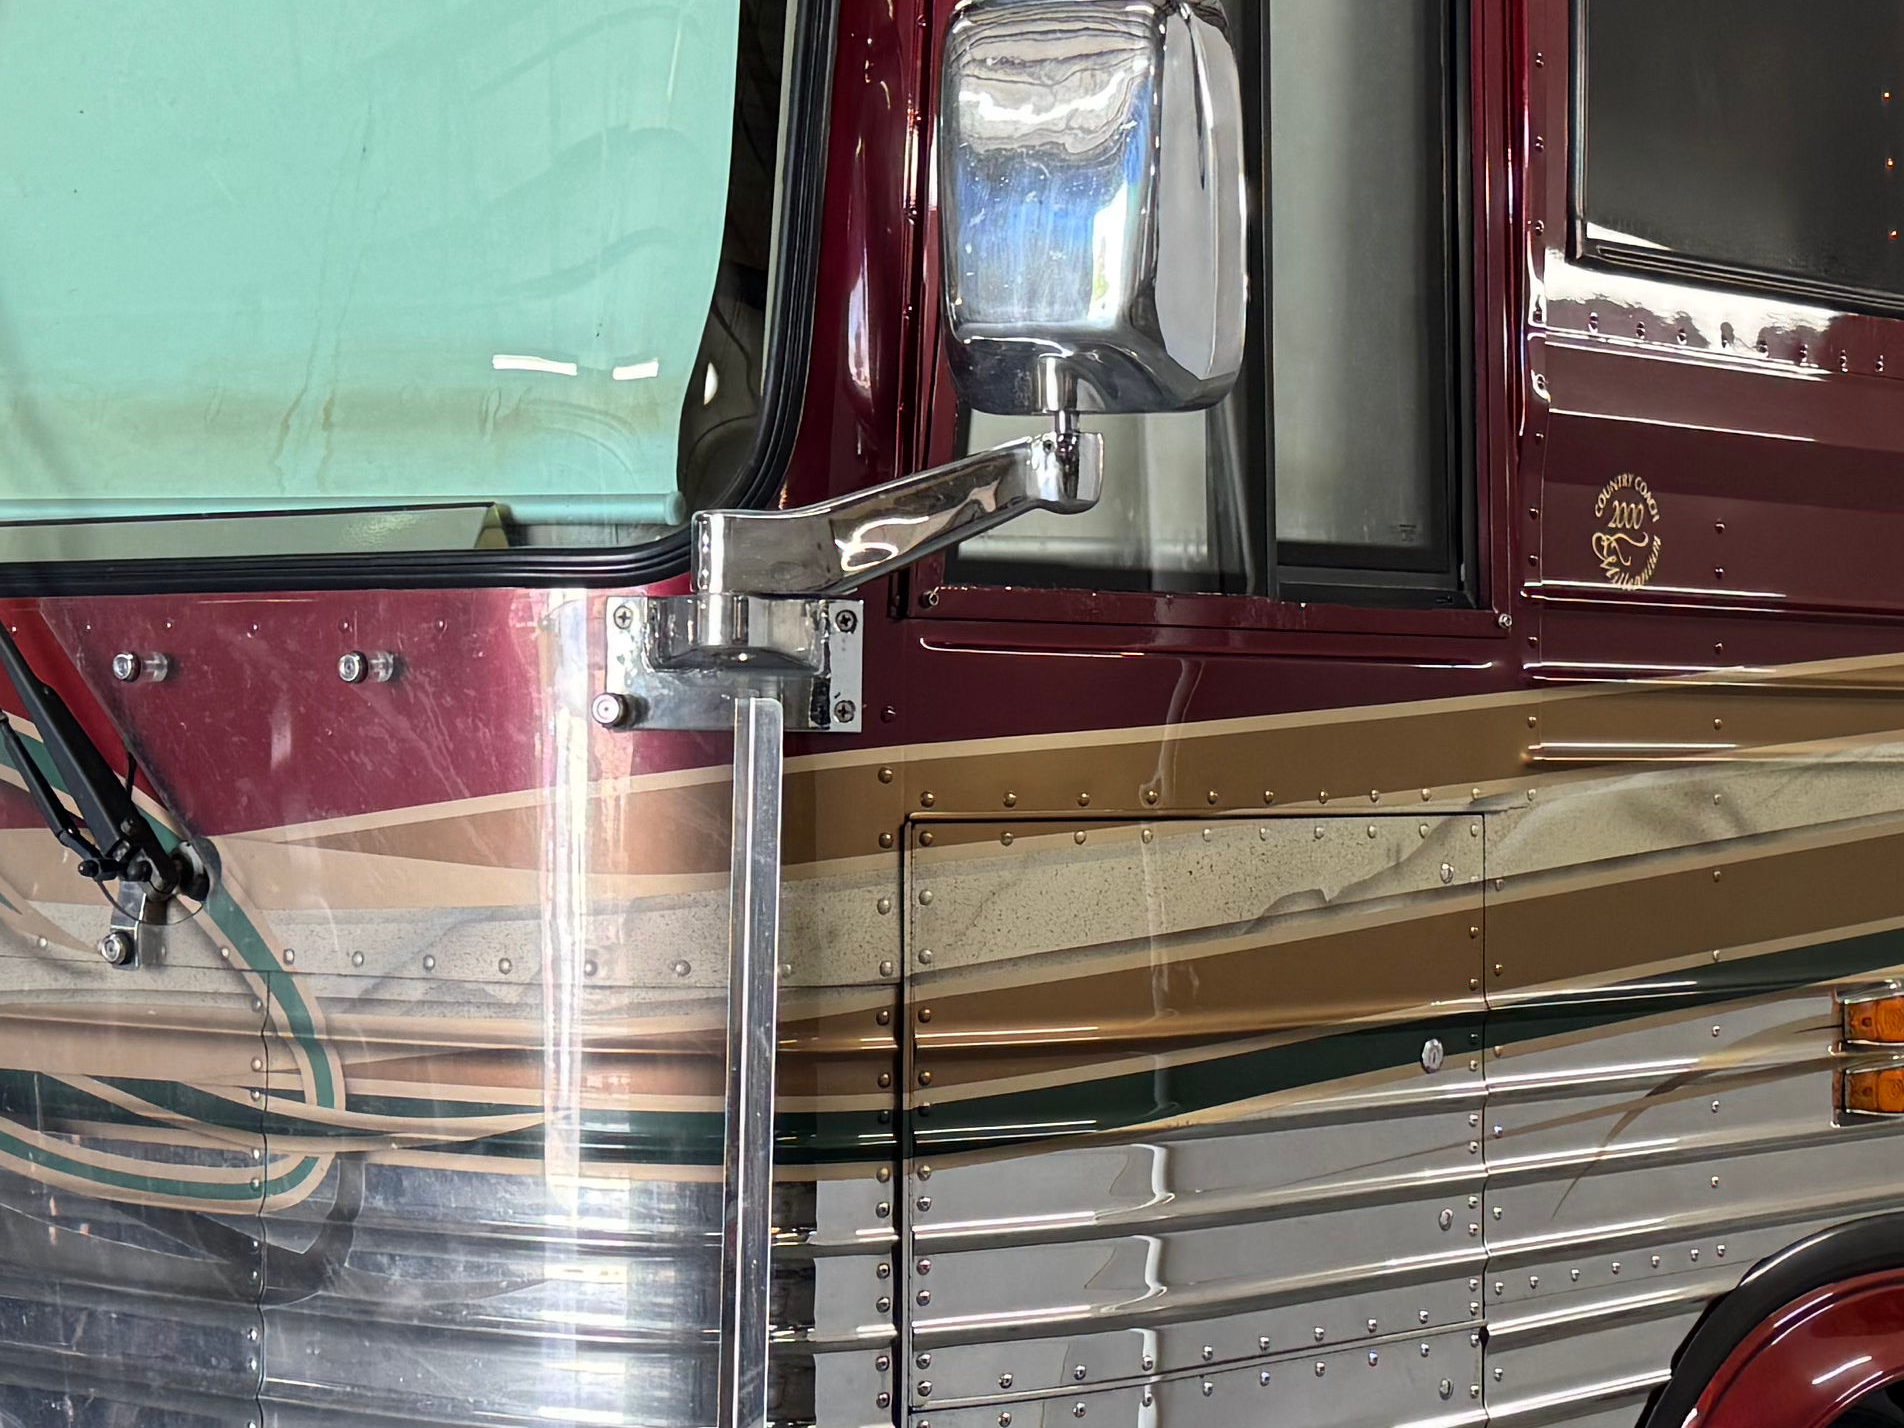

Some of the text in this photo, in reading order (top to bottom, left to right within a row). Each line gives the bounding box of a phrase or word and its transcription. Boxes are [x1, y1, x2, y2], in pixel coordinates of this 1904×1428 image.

[1594, 473, 1660, 523] COUNTRY COACH
[1607, 499, 1645, 530] 2000
